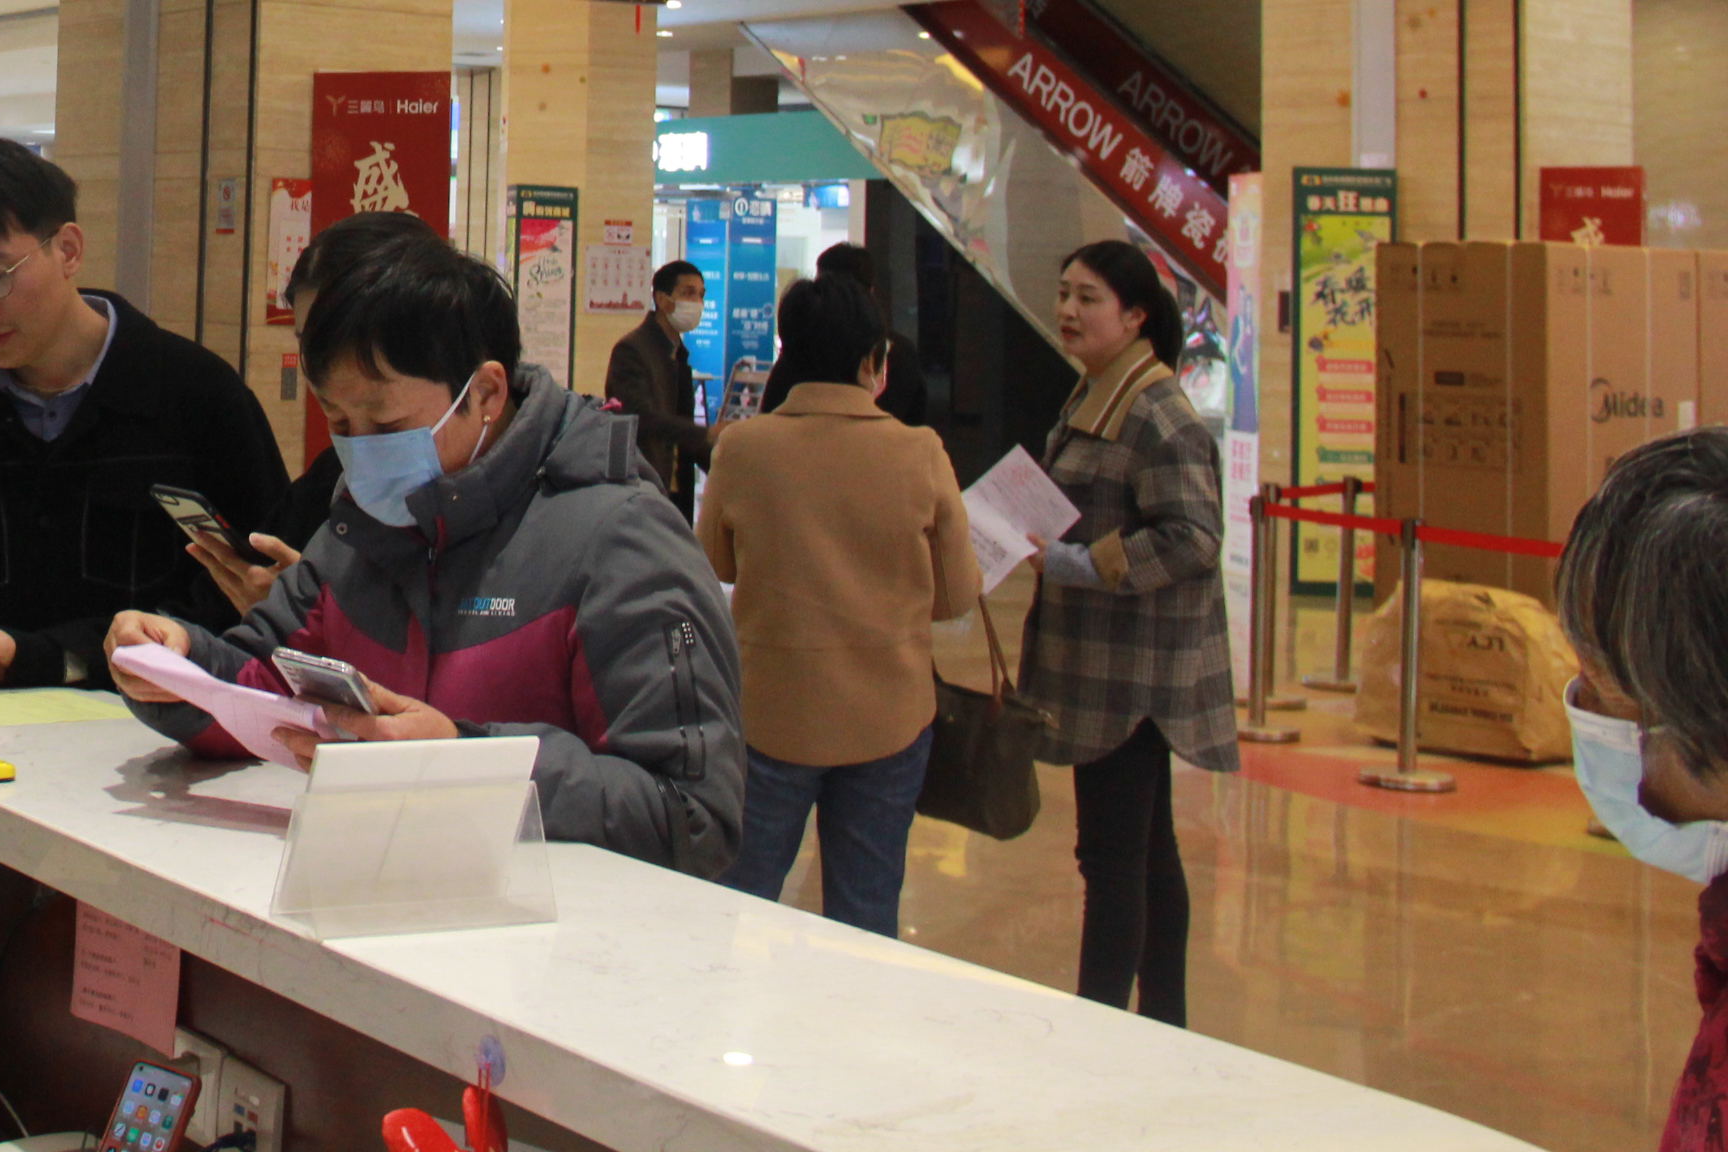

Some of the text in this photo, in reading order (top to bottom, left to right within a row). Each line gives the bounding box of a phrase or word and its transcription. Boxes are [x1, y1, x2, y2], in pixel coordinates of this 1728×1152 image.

[396, 98, 439, 115] Haier
[1008, 52, 1123, 161] ARROW
[1117, 71, 1234, 176] ARROW
